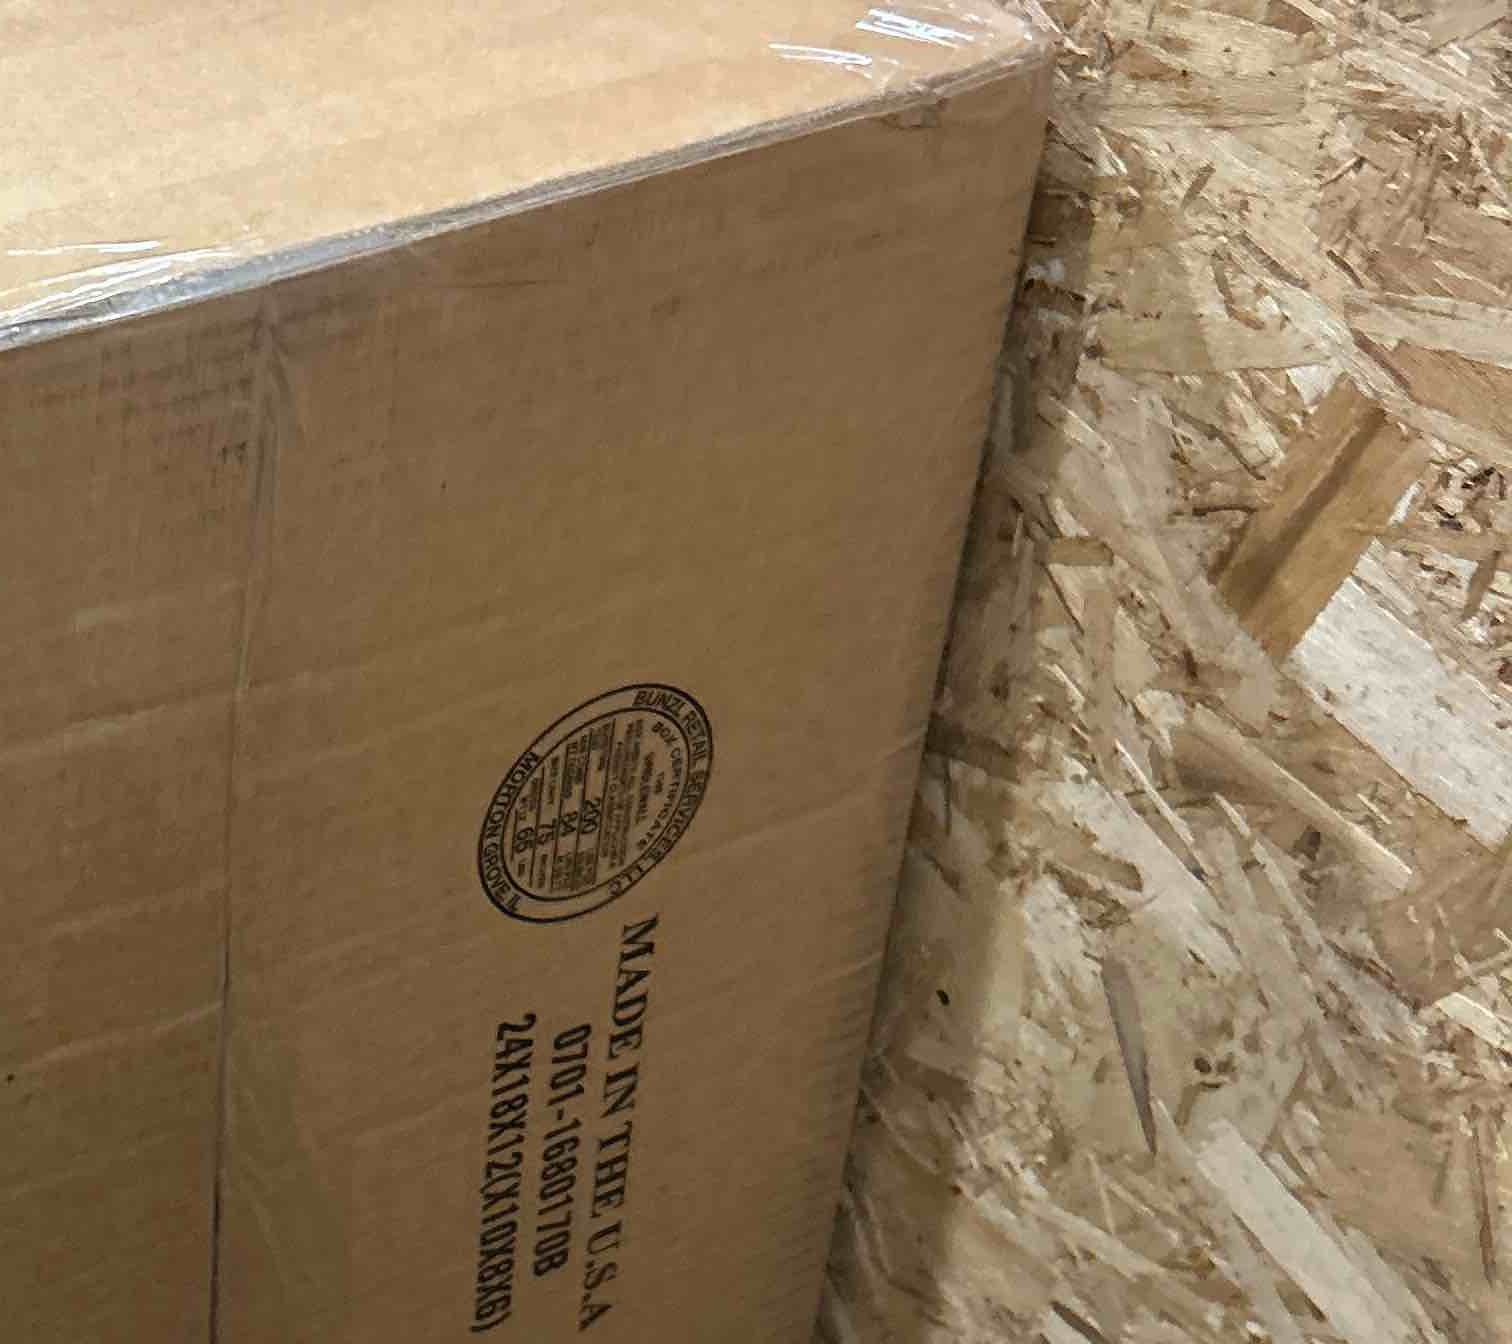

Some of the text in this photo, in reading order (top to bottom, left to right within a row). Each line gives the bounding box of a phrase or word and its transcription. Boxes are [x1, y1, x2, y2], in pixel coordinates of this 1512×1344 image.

[608, 913, 658, 1060] MADE
[601, 1061, 641, 1118] IN
[590, 1119, 633, 1218] THE
